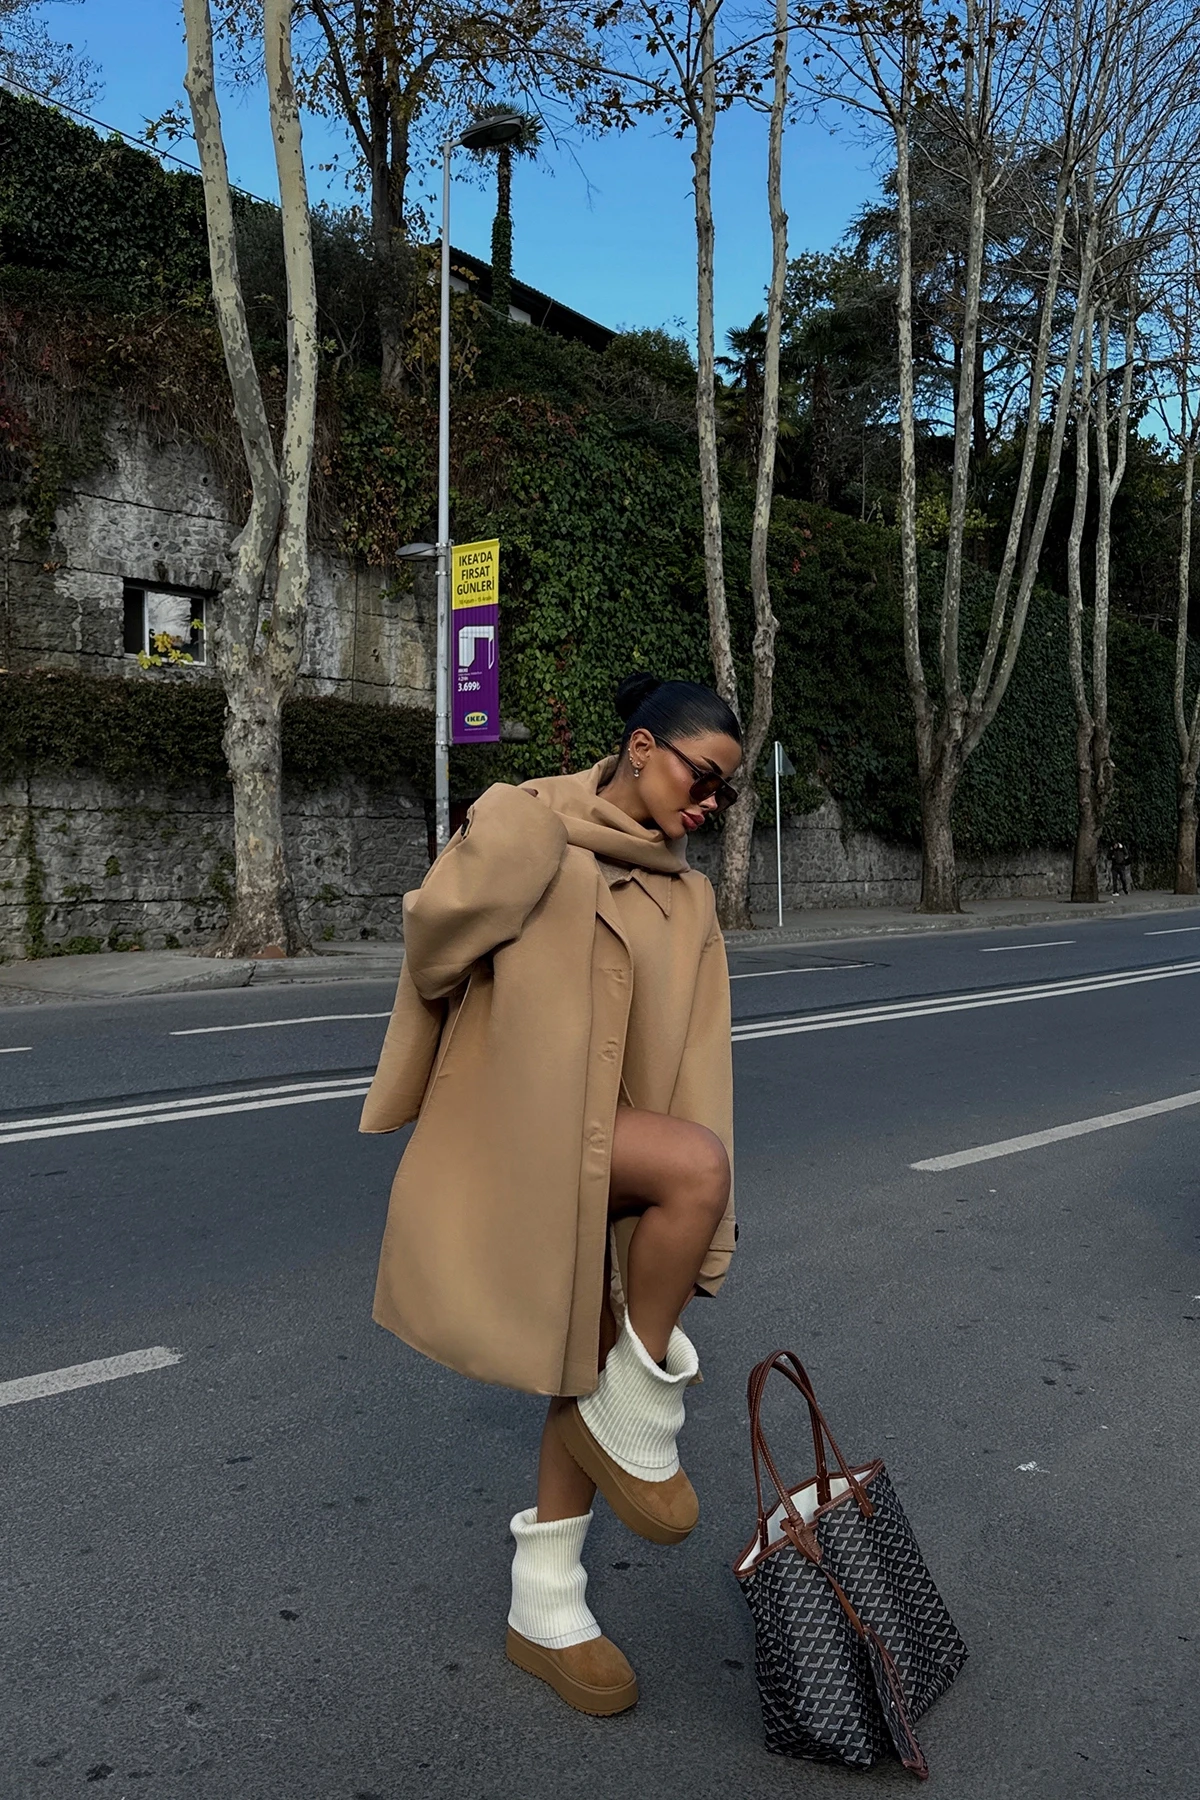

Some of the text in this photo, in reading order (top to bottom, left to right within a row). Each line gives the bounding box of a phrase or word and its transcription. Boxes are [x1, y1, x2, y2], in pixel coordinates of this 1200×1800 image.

[459, 551, 493, 566] IKEA'DA
[461, 565, 490, 580] FIRSAT
[457, 576, 494, 595] GÜNLERİ
